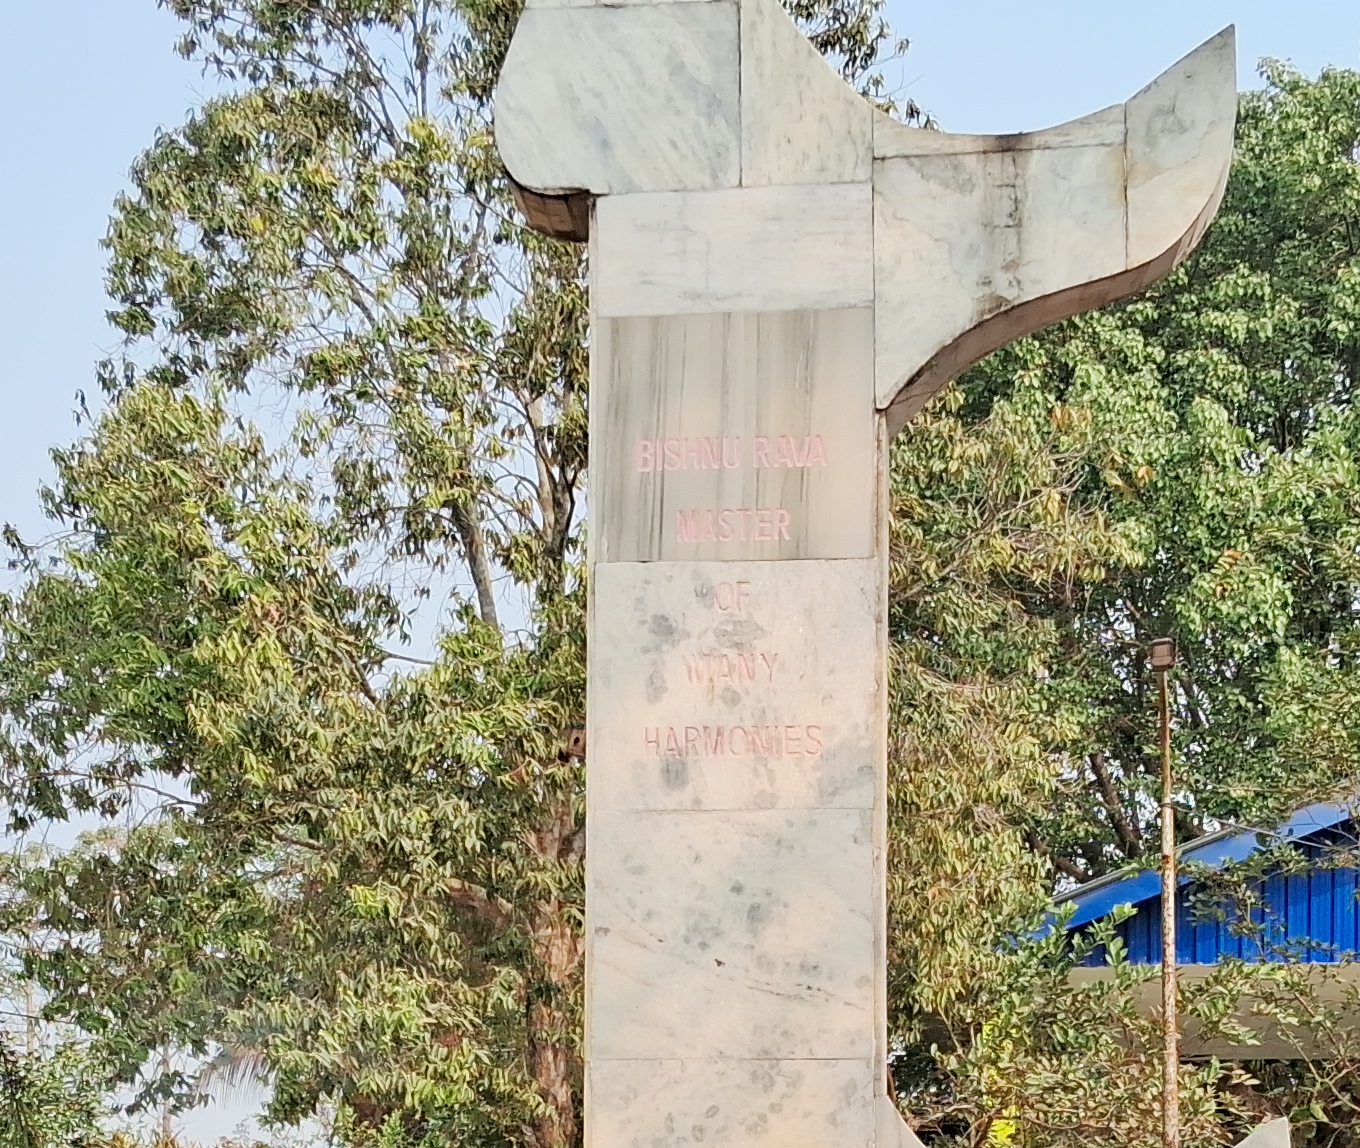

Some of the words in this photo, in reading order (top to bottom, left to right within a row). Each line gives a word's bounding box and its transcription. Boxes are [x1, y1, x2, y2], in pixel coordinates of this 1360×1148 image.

[637, 436, 741, 473] BISHNU
[752, 434, 828, 468] RAVA
[676, 507, 792, 543] MASTER
[713, 580, 751, 614] OF
[682, 652, 779, 685] MANY
[643, 724, 824, 760] HARMONIES
